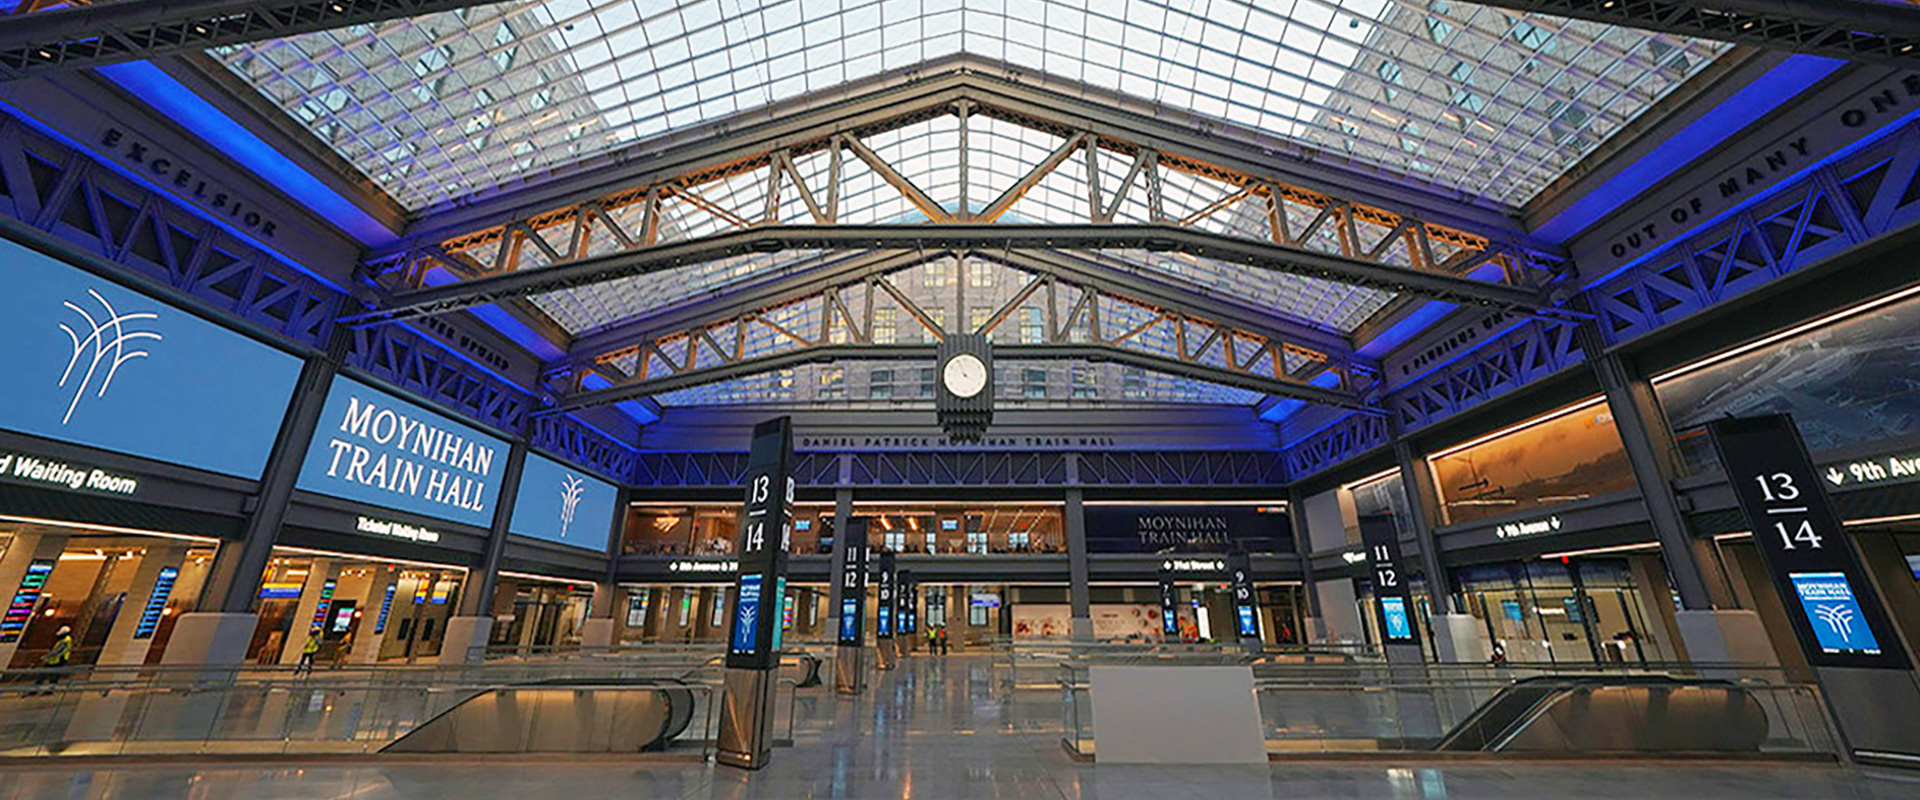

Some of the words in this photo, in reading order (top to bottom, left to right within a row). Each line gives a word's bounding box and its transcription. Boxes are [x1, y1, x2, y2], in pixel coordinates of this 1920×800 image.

[102, 127, 278, 238] EXCELSIOR
[1610, 222, 1657, 258] OUT
[1670, 197, 1702, 225] OF
[1718, 136, 1808, 198] MANY
[340, 397, 494, 477] MOYNIHAN
[802, 437, 856, 447] DANIEL
[864, 437, 929, 447] PATRICK
[1026, 437, 1071, 447] TRAIN
[1079, 437, 1116, 447] HALL
[14, 456, 87, 490] Waiting
[86, 468, 137, 495] Room
[326, 438, 425, 497] TRAIN
[424, 467, 485, 512] HALL
[1849, 461, 1887, 482] 9th
[751, 474, 770, 504] 13
[1754, 472, 1800, 502] 13
[1138, 515, 1228, 530] MOYNIHAN
[745, 522, 765, 552] 14
[1139, 530, 1188, 545] TRAIN
[1190, 530, 1232, 545] HALL
[1774, 519, 1823, 550] 14
[847, 547, 858, 562] 11
[1374, 544, 1390, 561] 11
[844, 571, 858, 588] 12
[1235, 571, 1245, 583] 9
[1378, 569, 1398, 587] 12
[1237, 587, 1250, 600] 10
